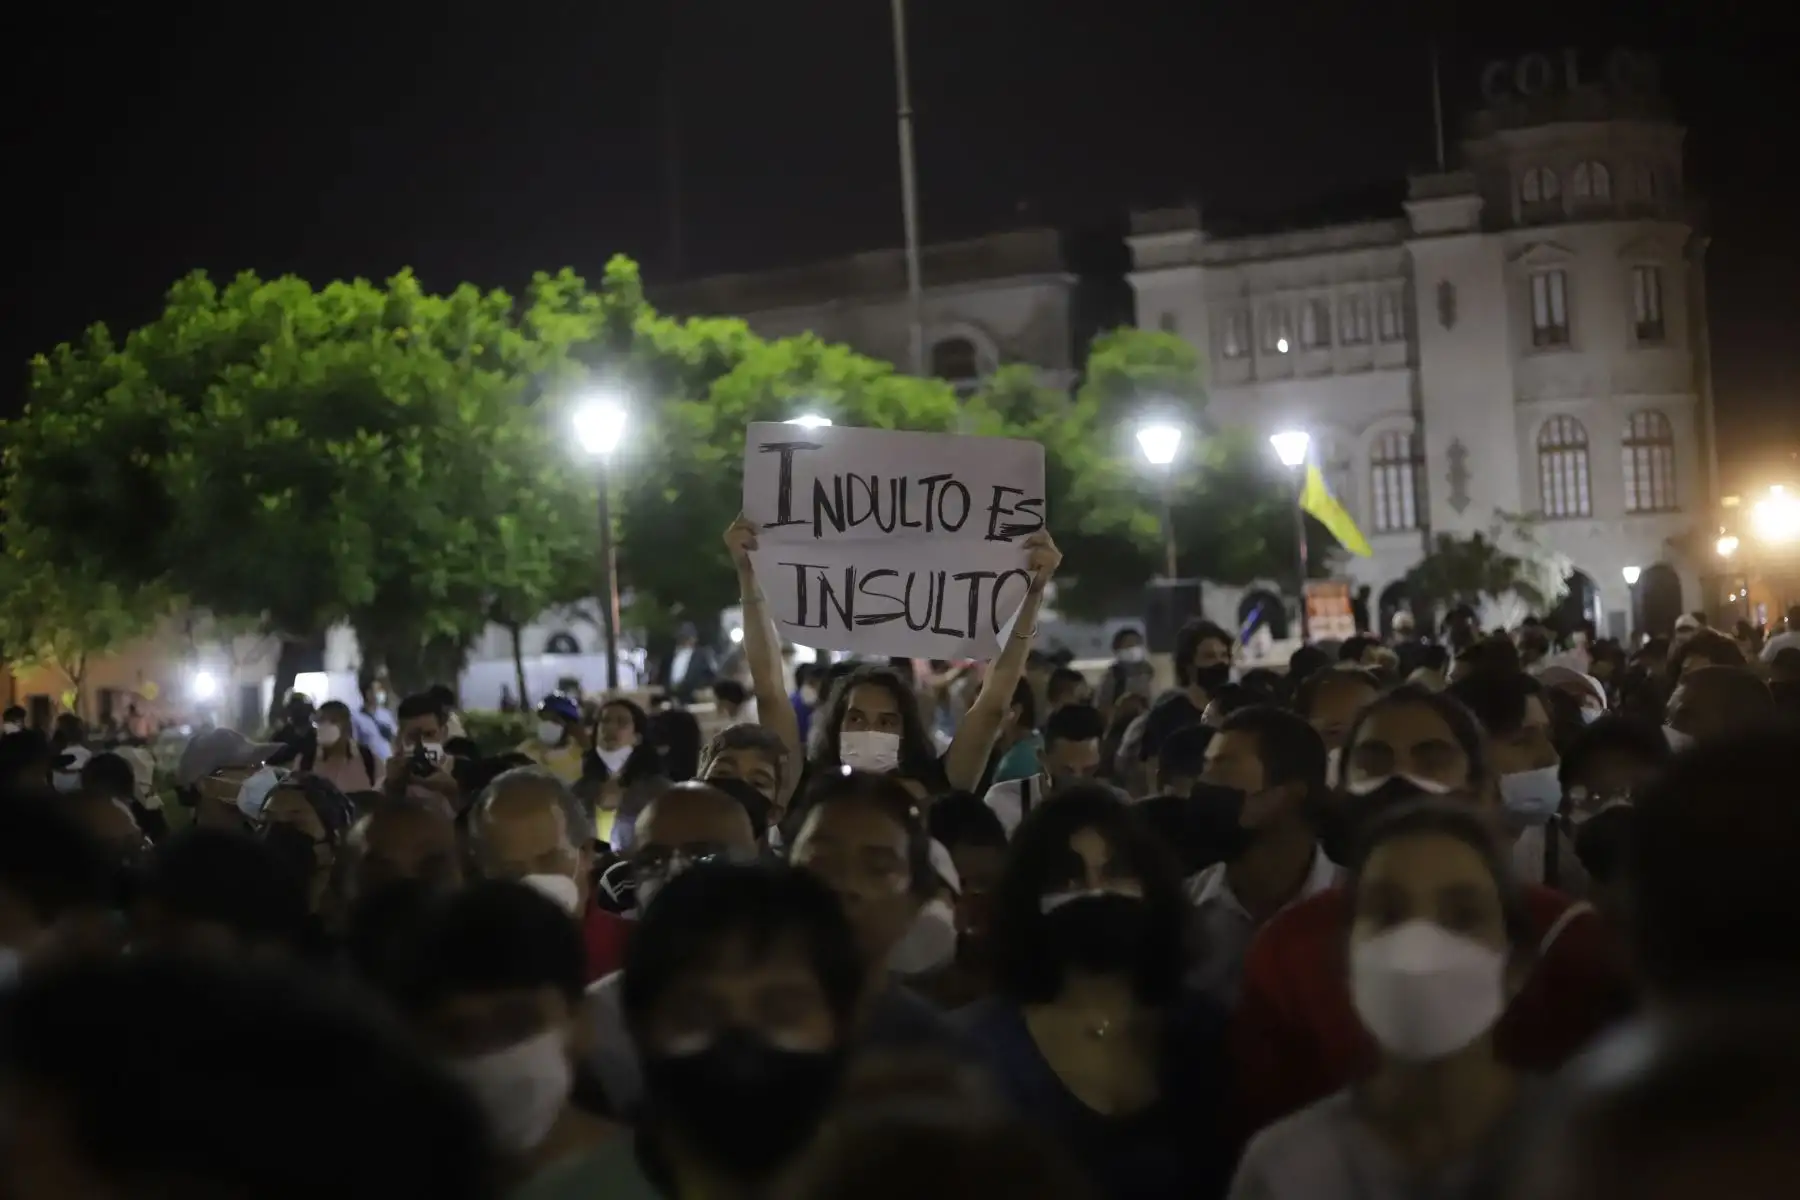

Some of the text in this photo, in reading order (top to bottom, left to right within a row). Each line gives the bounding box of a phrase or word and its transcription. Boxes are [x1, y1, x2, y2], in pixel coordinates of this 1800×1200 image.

[759, 442, 1044, 541] INDULTO ES
[778, 562, 1031, 638] INSULTO
